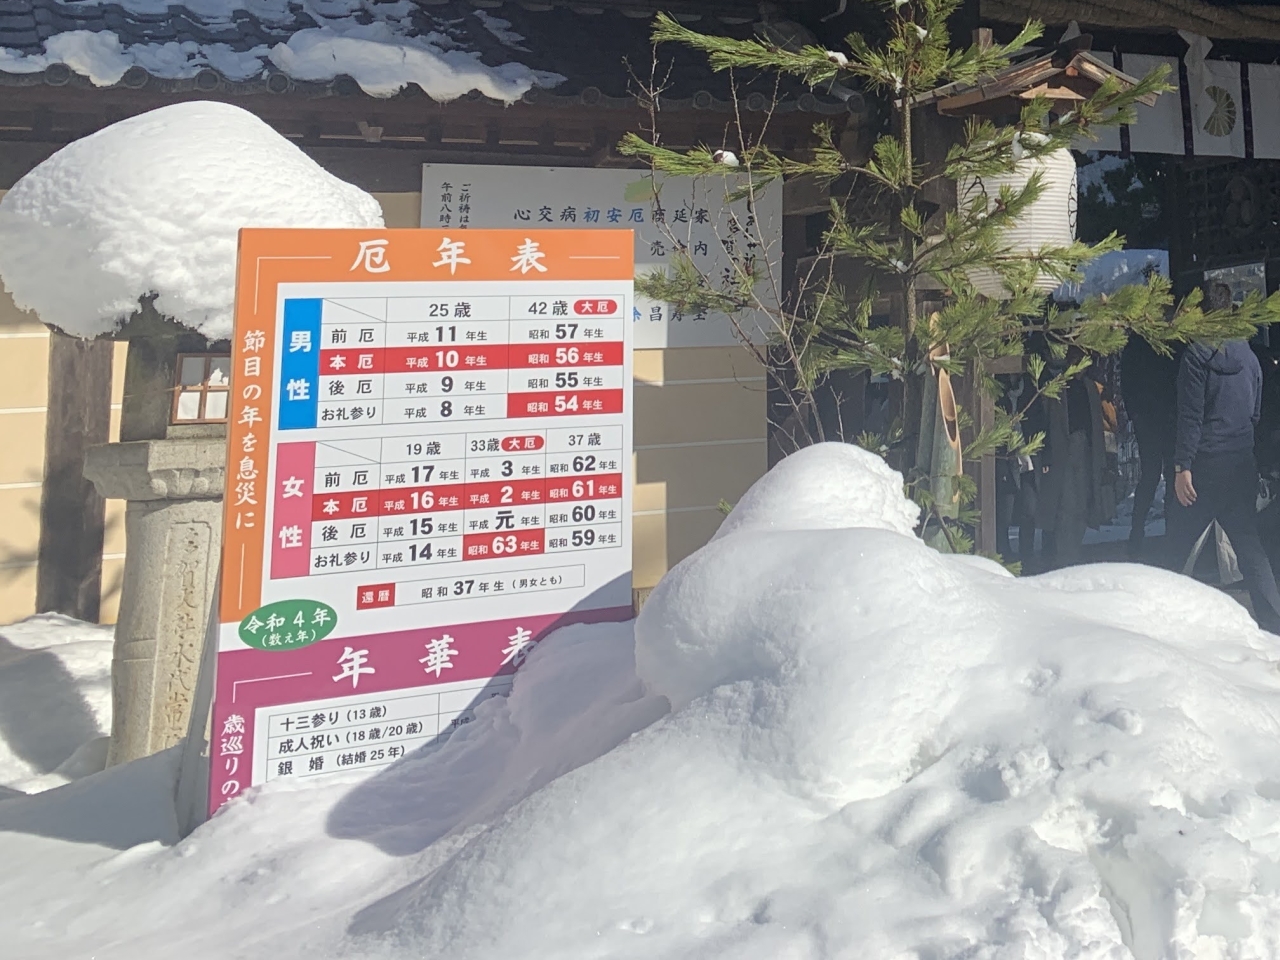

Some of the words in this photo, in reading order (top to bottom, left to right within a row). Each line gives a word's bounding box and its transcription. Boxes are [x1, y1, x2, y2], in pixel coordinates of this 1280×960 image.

[349, 237, 548, 276] 厄年表
[429, 301, 471, 319] 25歳
[528, 300, 569, 317] 42歳
[581, 300, 608, 314] 大厄
[331, 327, 375, 344] 前厄
[286, 330, 313, 401] 男性
[329, 353, 374, 371] 本厄
[328, 379, 373, 396] 後厄
[321, 406, 376, 421] お礼参り
[233, 329, 267, 530] 節目の年を息災に
[406, 441, 441, 456] 19歳
[470, 437, 500, 452] 33歳
[508, 436, 536, 450] 大厄
[568, 432, 601, 447] 37歳
[324, 470, 369, 488] 前厄
[279, 476, 305, 549] 女性
[322, 496, 368, 515] 本厄
[321, 523, 367, 541] 後厄
[314, 550, 370, 568] お礼参り
[243, 607, 332, 634] 令和4年
